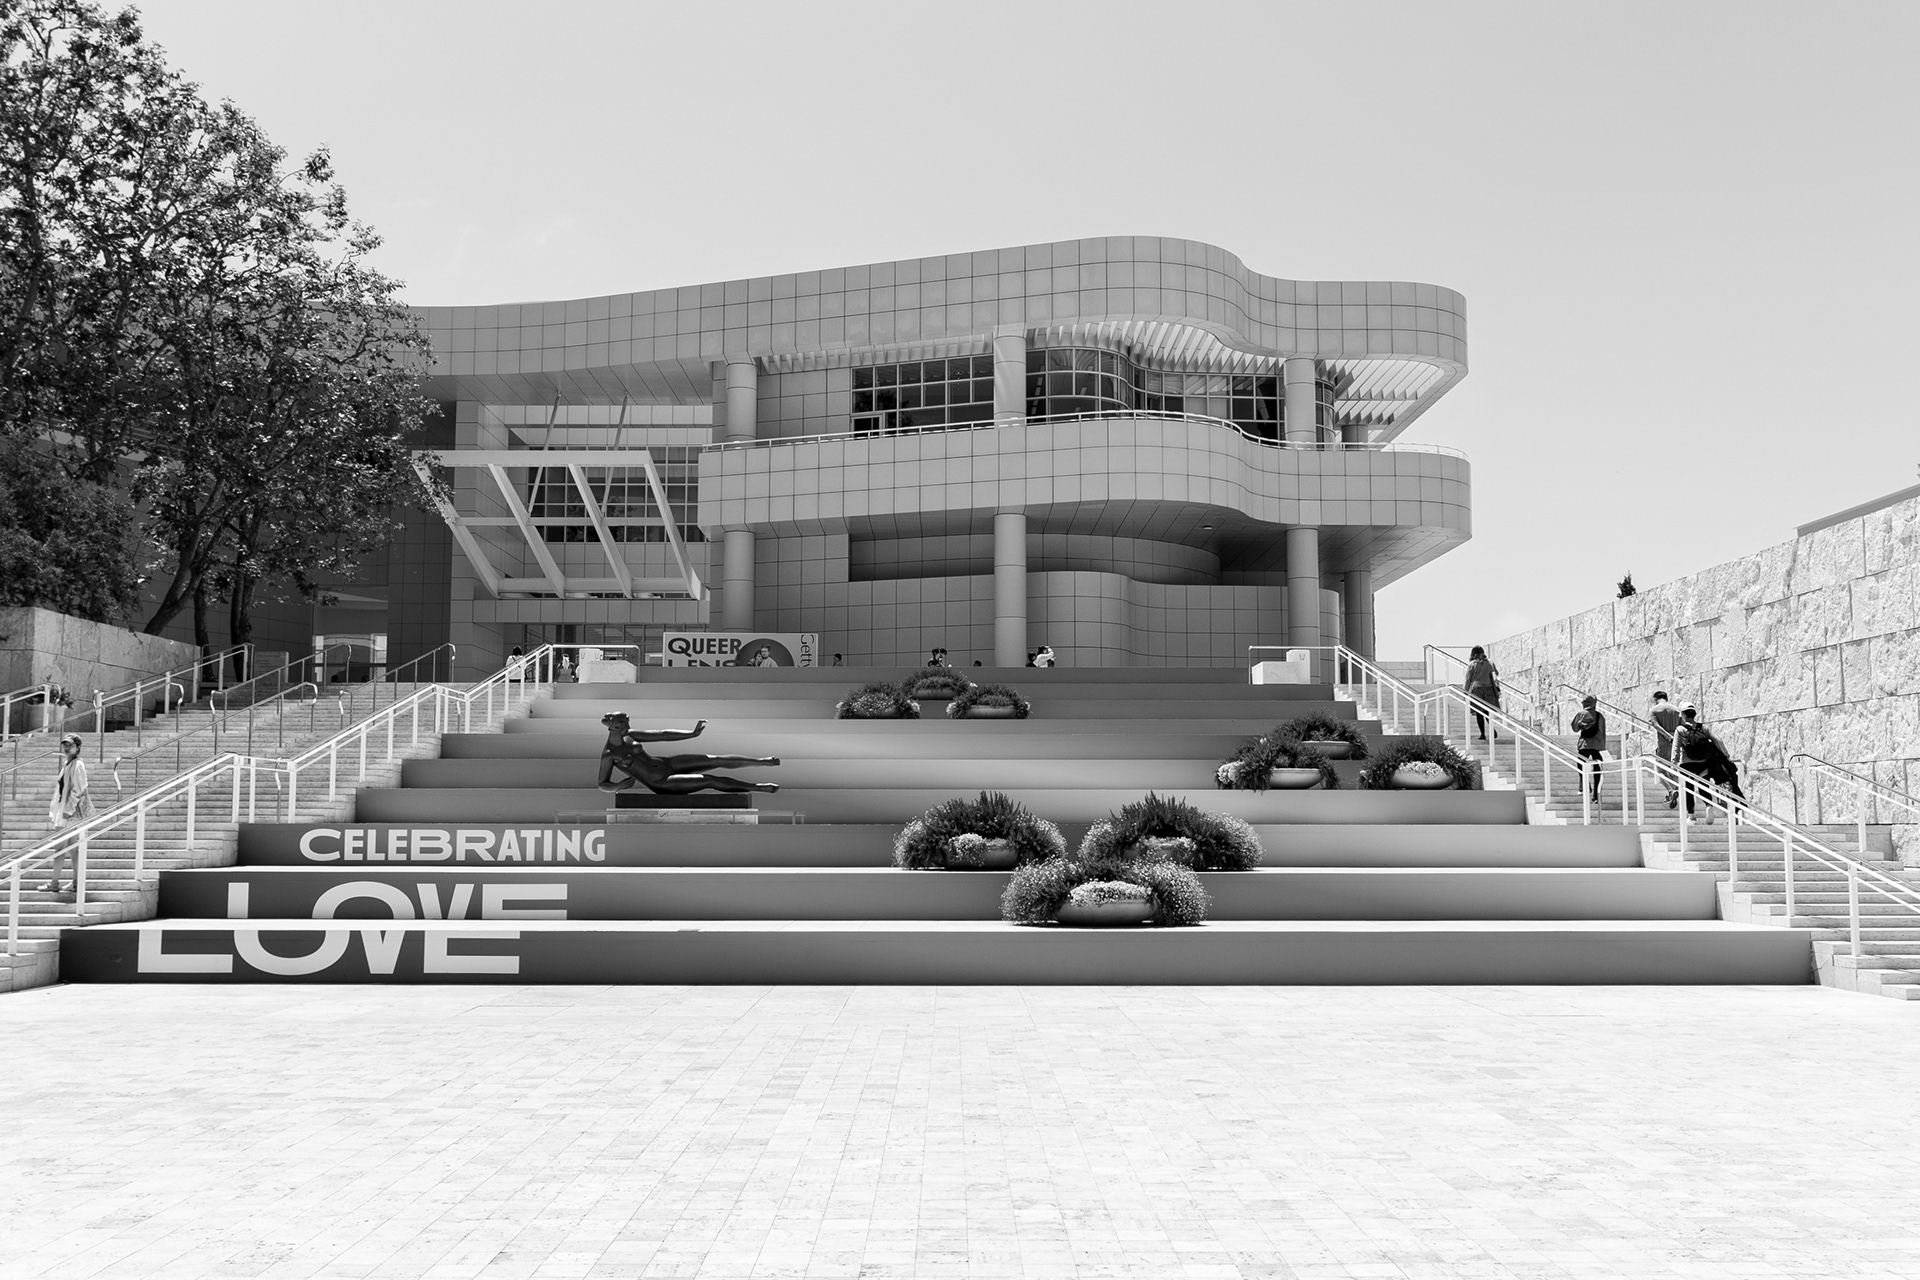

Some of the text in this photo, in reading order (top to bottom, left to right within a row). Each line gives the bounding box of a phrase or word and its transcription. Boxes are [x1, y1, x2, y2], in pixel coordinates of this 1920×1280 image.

[667, 637, 742, 658] QUEER
[299, 828, 606, 862] CELEBRATING
[137, 880, 568, 976] LOVE
